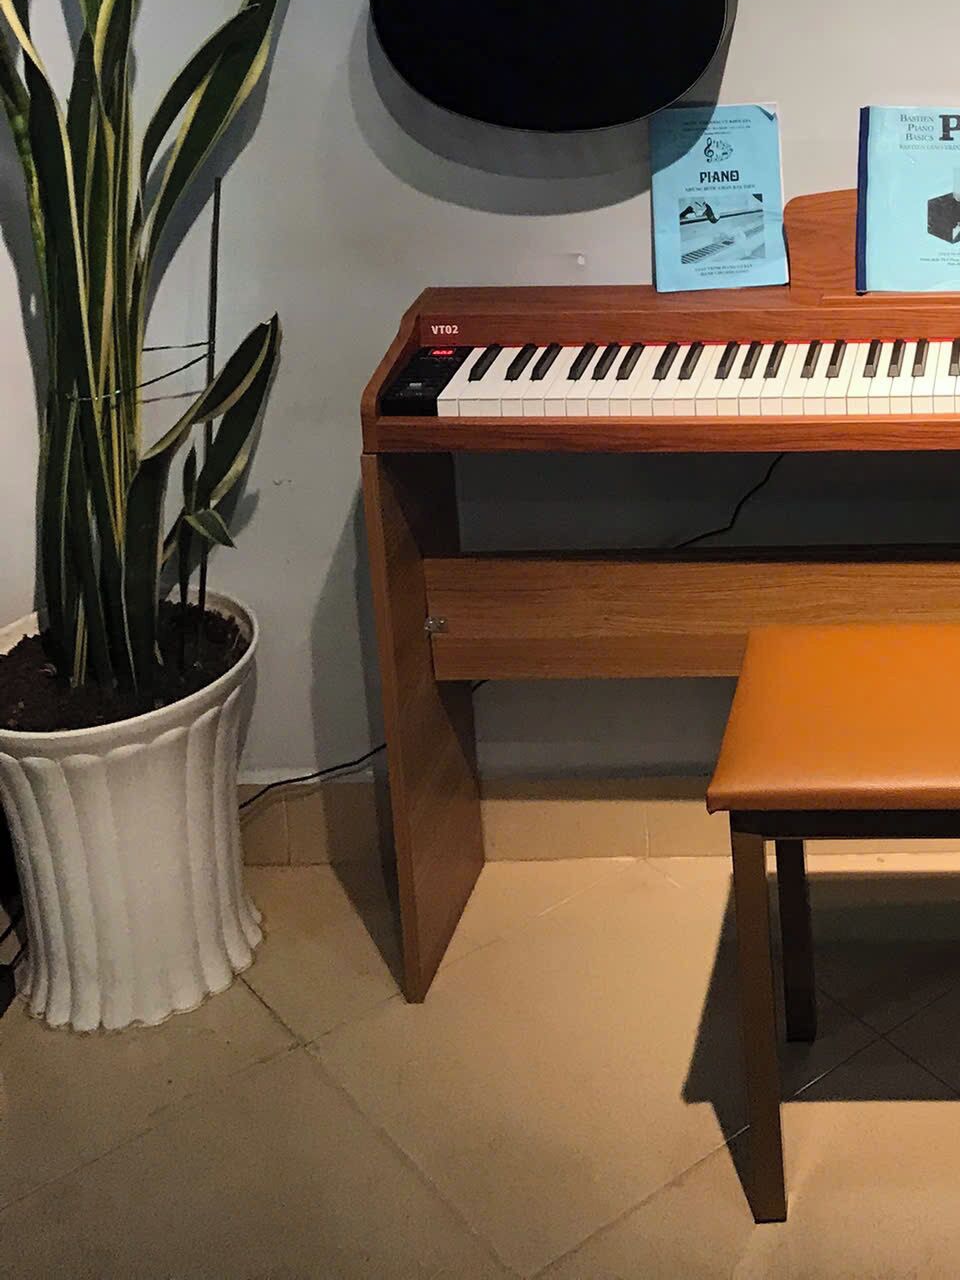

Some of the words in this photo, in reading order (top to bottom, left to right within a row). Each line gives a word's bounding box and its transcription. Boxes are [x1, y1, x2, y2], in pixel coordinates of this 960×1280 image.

[908, 123, 934, 132] PIANO
[906, 133, 934, 141] BASICS
[700, 170, 740, 184] PIANO
[431, 325, 459, 335] VT02
